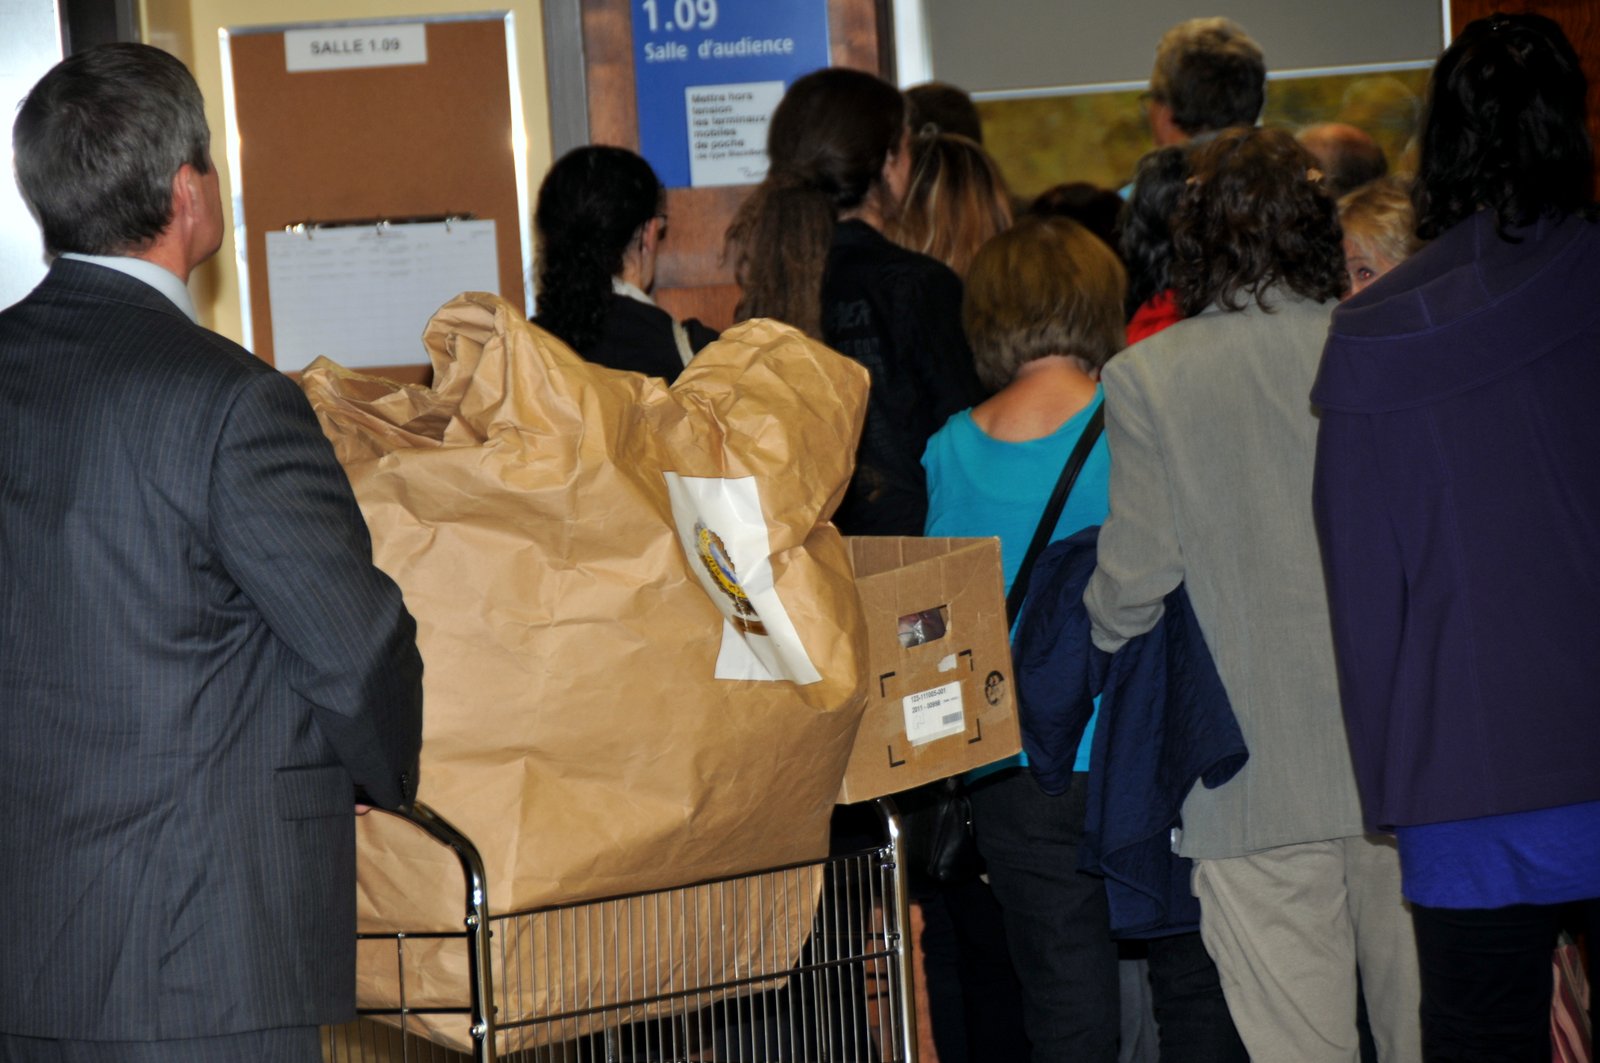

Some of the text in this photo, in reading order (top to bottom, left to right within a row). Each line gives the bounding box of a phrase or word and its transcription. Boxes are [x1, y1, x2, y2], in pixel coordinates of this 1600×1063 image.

[642, 0, 718, 31] 1.09
[310, 36, 400, 56] SALLE 1.09
[643, 37, 794, 62] Salle d'audience
